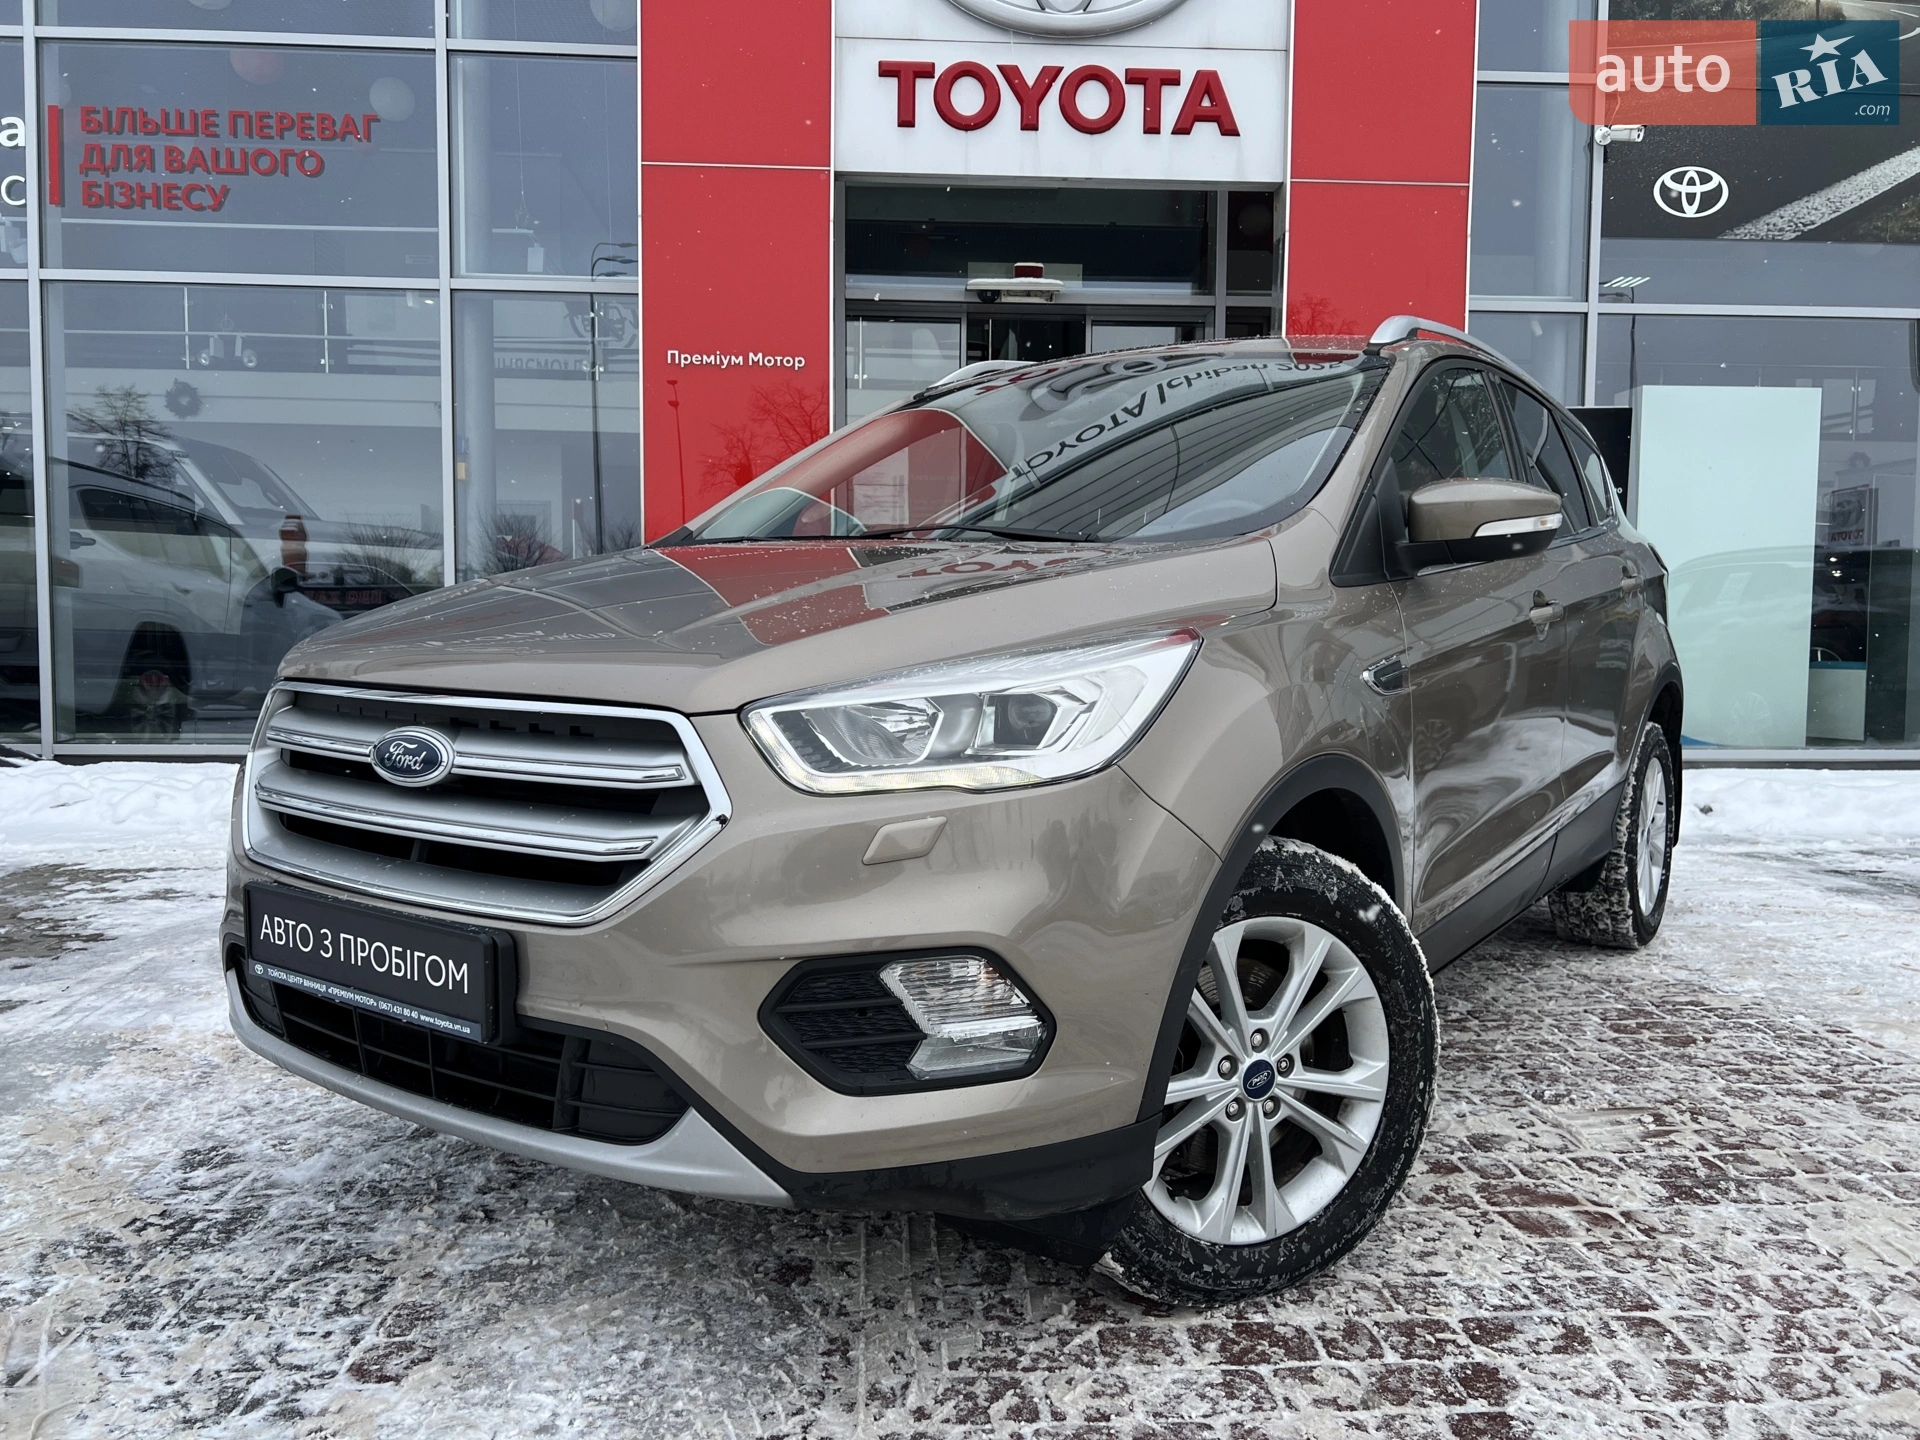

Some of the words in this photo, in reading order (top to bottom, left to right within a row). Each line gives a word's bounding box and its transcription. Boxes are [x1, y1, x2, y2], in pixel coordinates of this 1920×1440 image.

[878, 60, 1241, 137] TOYOTA
[79, 105, 218, 137] БІЛЬШЕ
[227, 109, 380, 142] ПЕРЕВАГ
[79, 143, 152, 175] ДЛЯ
[163, 145, 325, 177] ВАШОГО
[80, 180, 230, 212] БІЗНЕСУ
[667, 350, 743, 369] Преміум
[748, 352, 806, 371] Мотор
[384, 740, 427, 770] Ford
[260, 914, 313, 953] АВТО
[340, 933, 469, 994] ПРОБІГОМ
[267, 968, 288, 981] ТОЙОТА
[288, 973, 303, 985] ЦЕНТР
[303, 978, 327, 993] ВІННИЦЯ
[378, 1000, 393, 1012] (067)
[393, 1005, 402, 1014] 431
[403, 1008, 411, 1016] 80
[411, 1011, 418, 1019] 40
[420, 1014, 471, 1034] www.toyota.vn.ua
